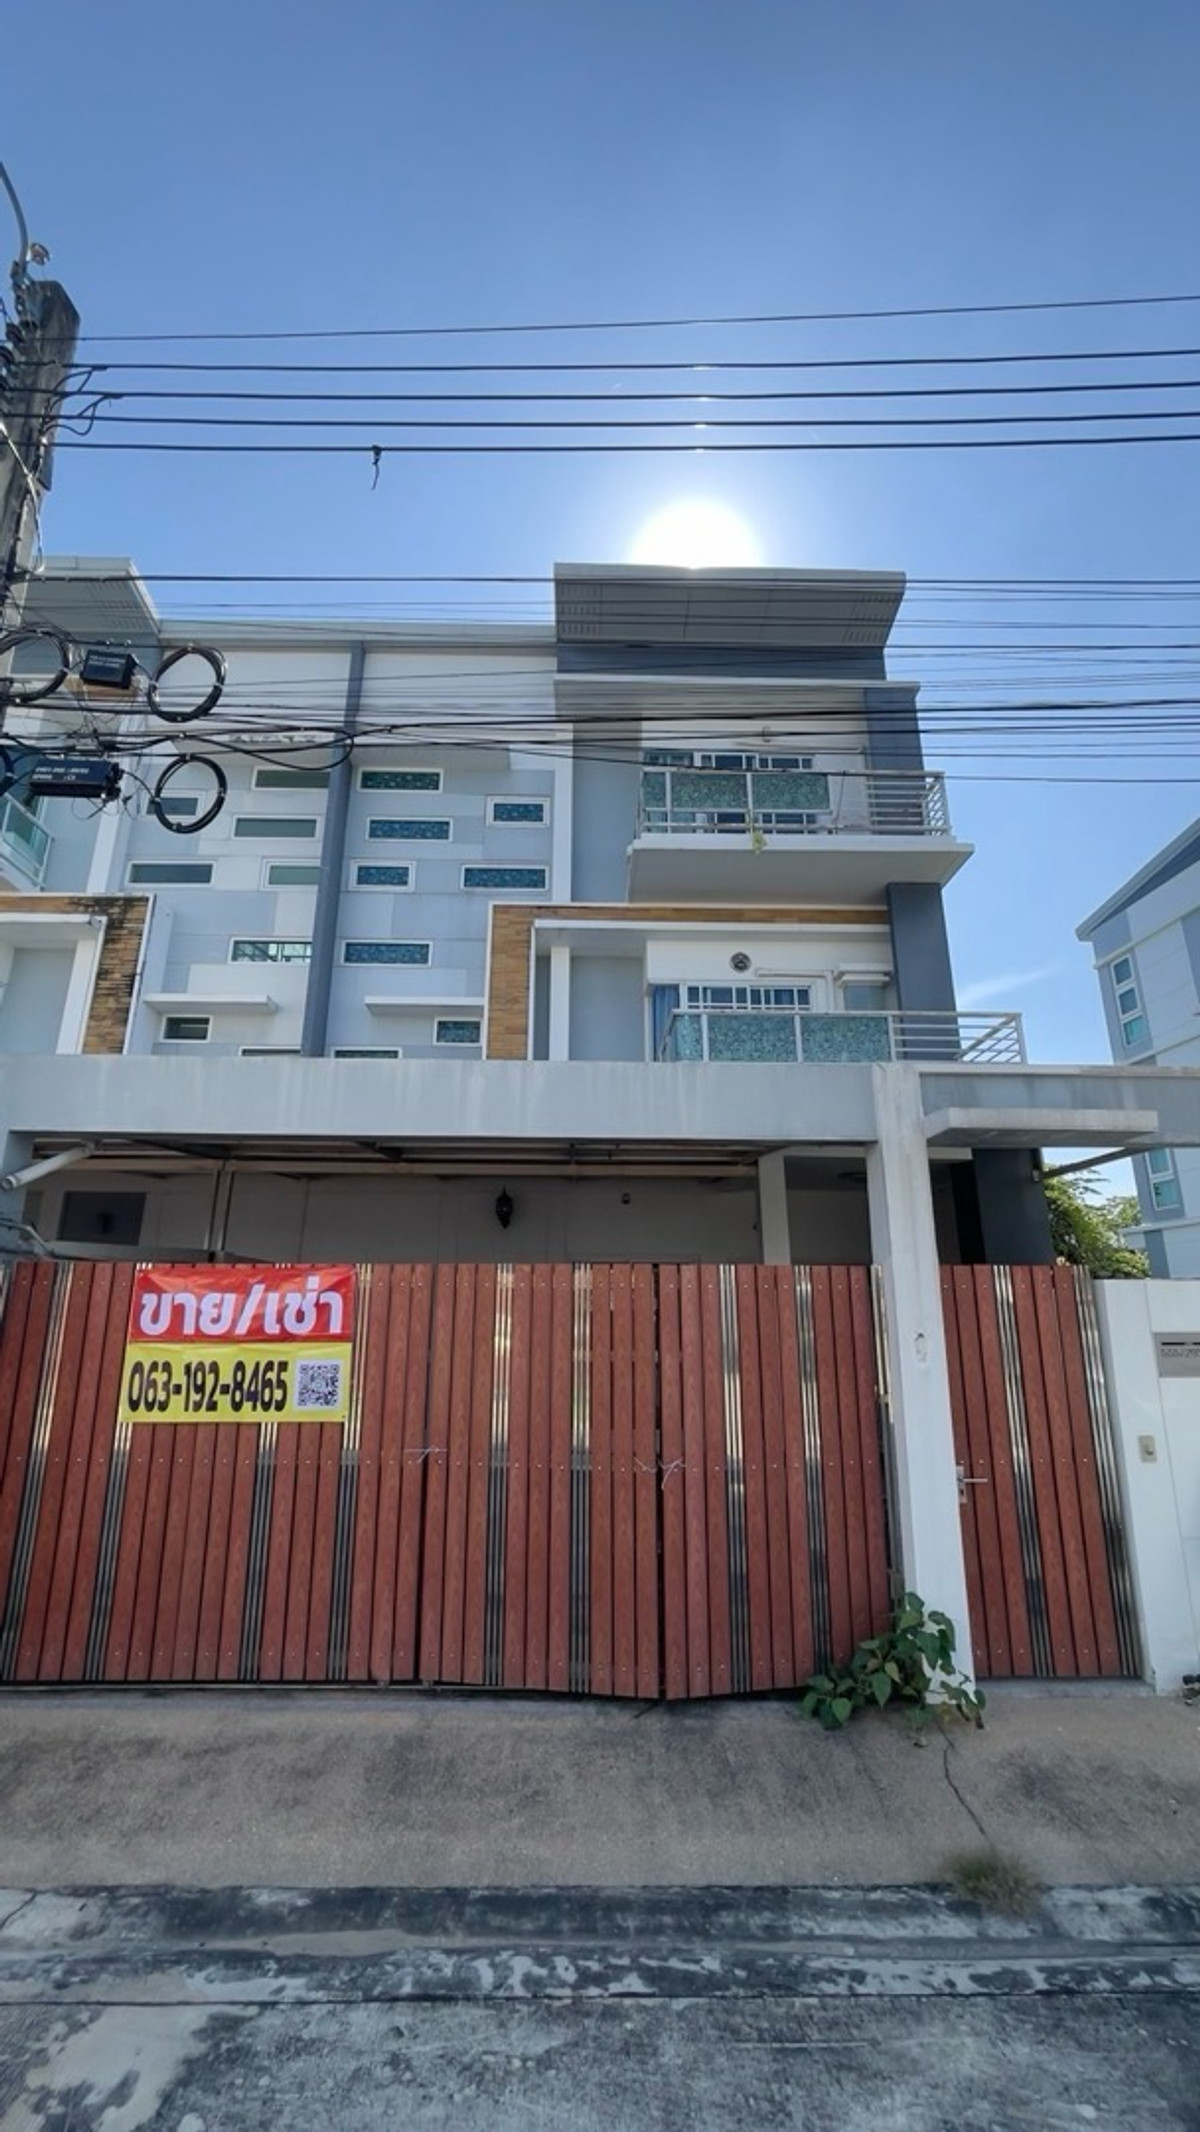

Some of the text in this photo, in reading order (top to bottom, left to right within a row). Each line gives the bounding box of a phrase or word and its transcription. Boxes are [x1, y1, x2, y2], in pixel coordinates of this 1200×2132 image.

[140, 1275, 343, 1335] ขาย/เช่า
[127, 1360, 289, 1412] 063-192-8465
